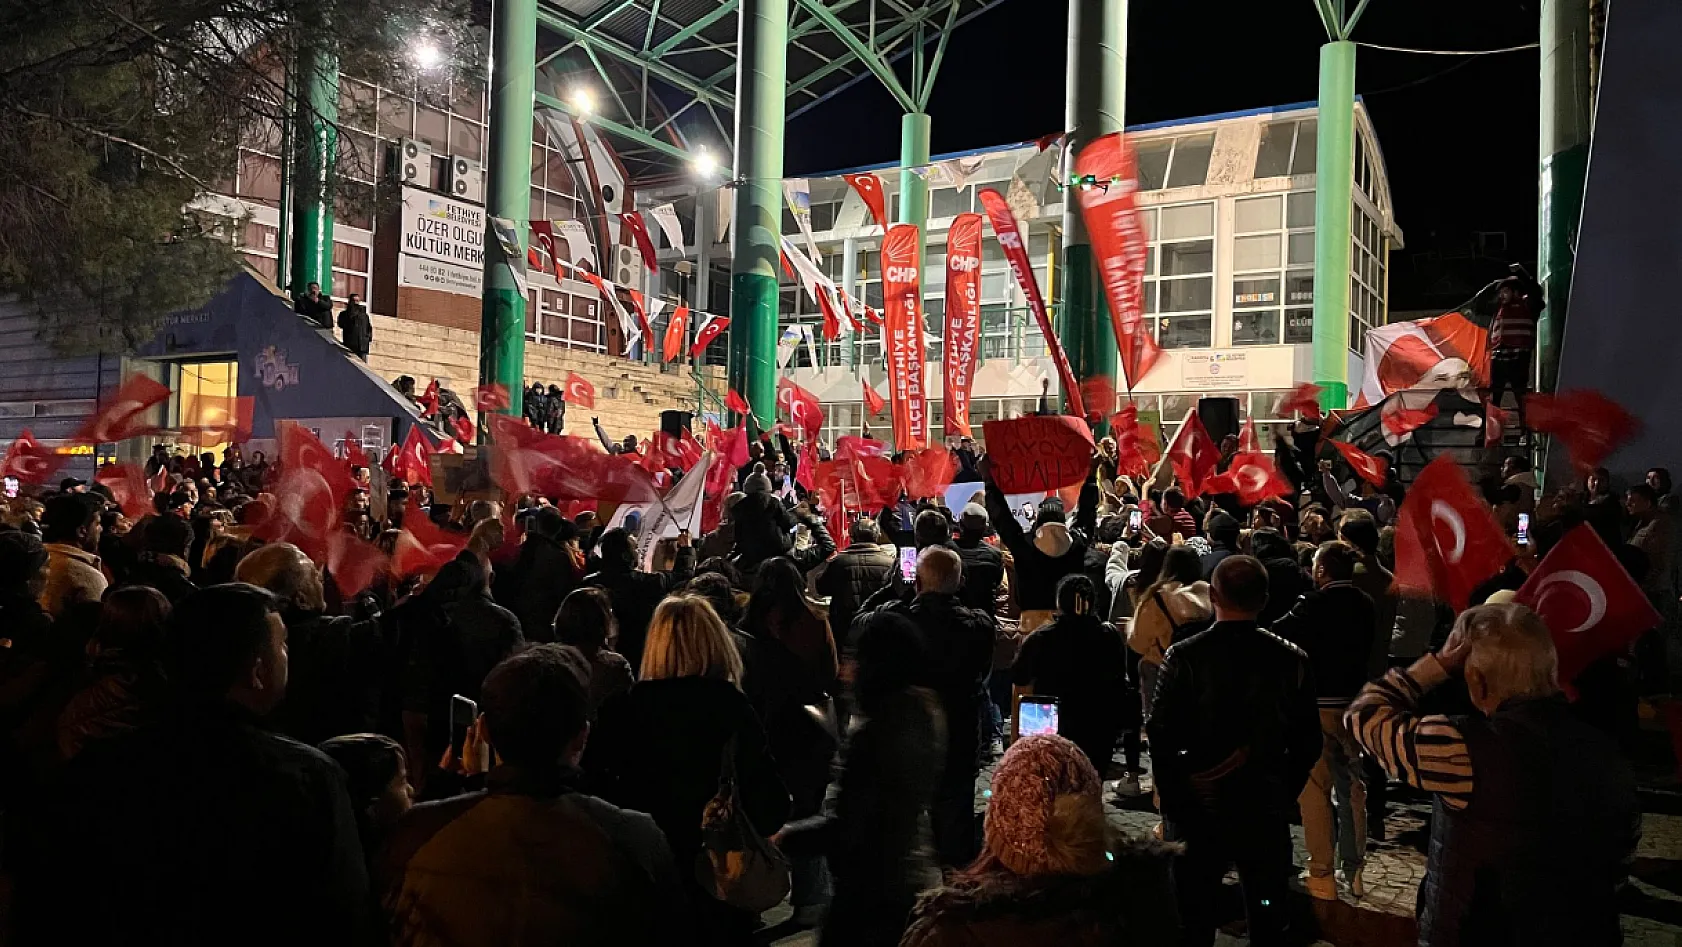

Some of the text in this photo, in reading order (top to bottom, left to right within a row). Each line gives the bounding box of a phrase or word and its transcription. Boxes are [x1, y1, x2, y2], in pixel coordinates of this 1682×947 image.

[418, 213, 449, 238] ÖZER
[405, 231, 451, 257] KÜLTÜR
[886, 266, 917, 283] CHP
[950, 255, 979, 273] CHP
[904, 293, 921, 394] BAŞKANLIĞI
[955, 282, 976, 386] BAŞKANLIĞI
[893, 329, 907, 400] FETHİYE
